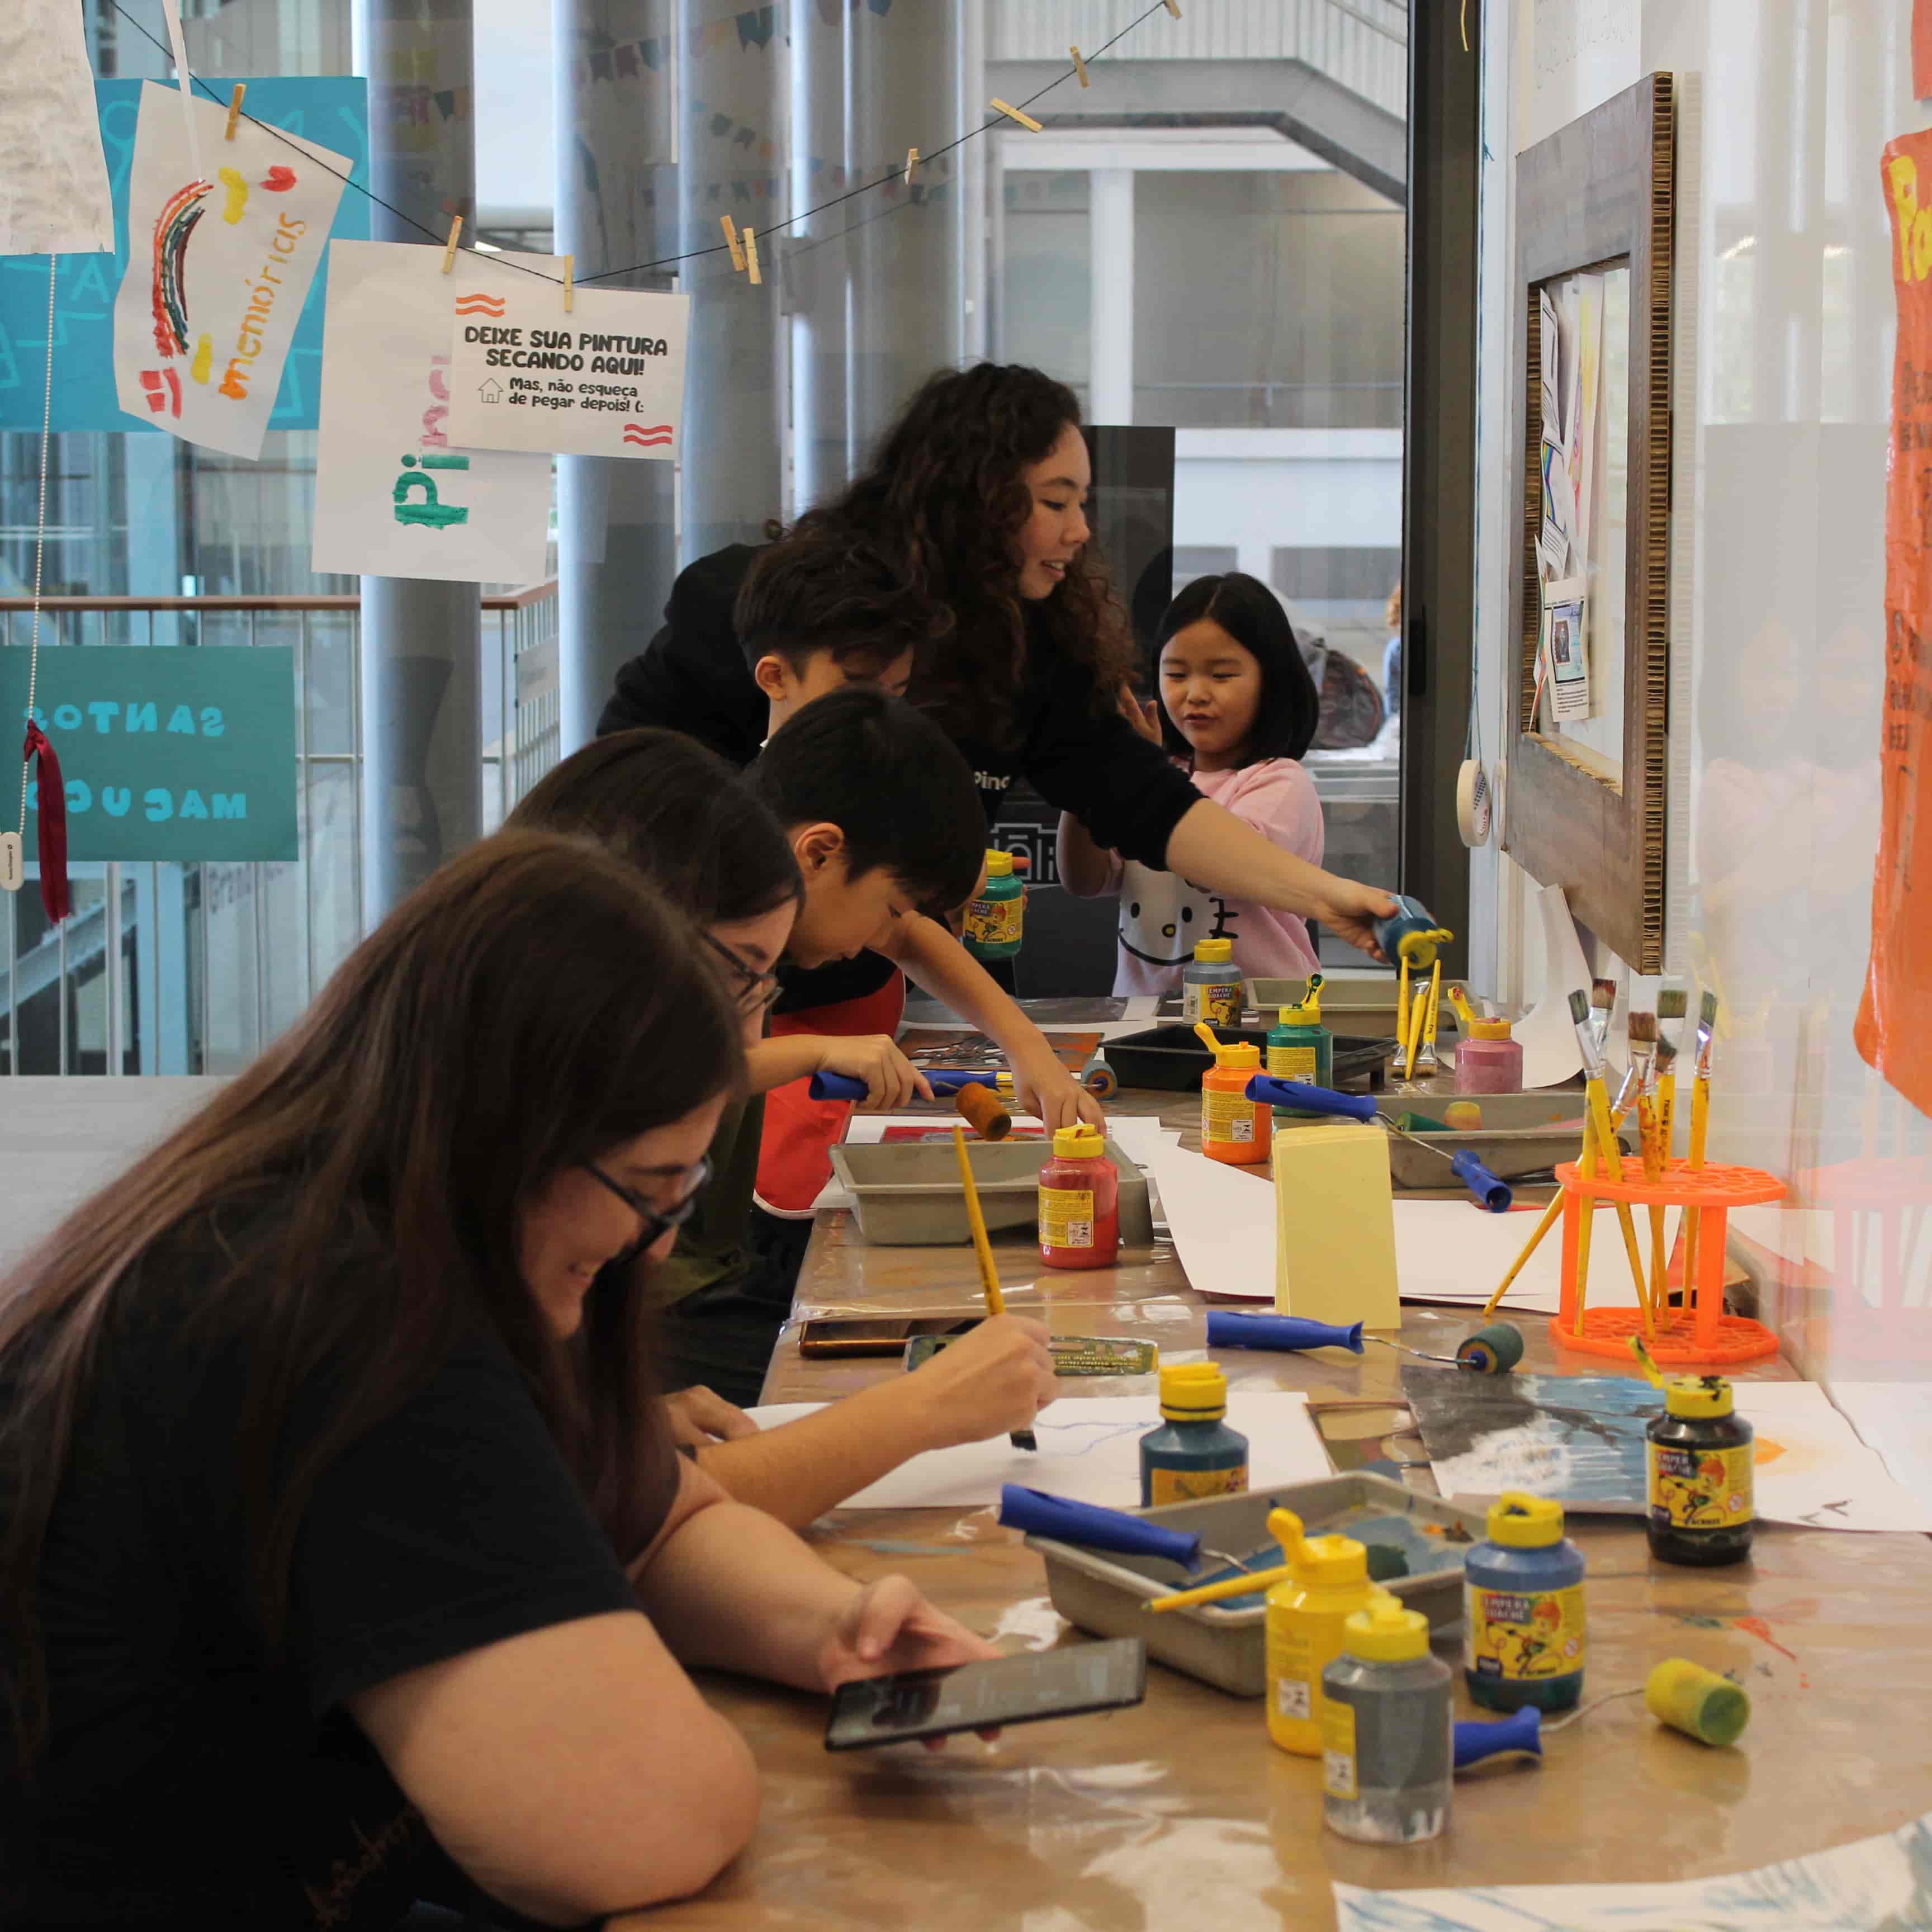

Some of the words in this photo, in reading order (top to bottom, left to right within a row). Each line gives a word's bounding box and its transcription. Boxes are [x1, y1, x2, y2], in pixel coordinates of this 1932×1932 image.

[465, 326, 522, 346] DEIXE
[529, 330, 571, 349] SUA
[579, 333, 667, 356] PINTURA
[486, 348, 584, 371] SECANDO
[591, 356, 644, 375] AQUI!
[509, 377, 543, 392] Mas,
[548, 379, 573, 392] não
[579, 383, 637, 400] esqueça
[509, 392, 527, 404] de
[532, 395, 575, 410] pegar
[580, 397, 630, 412] depois!
